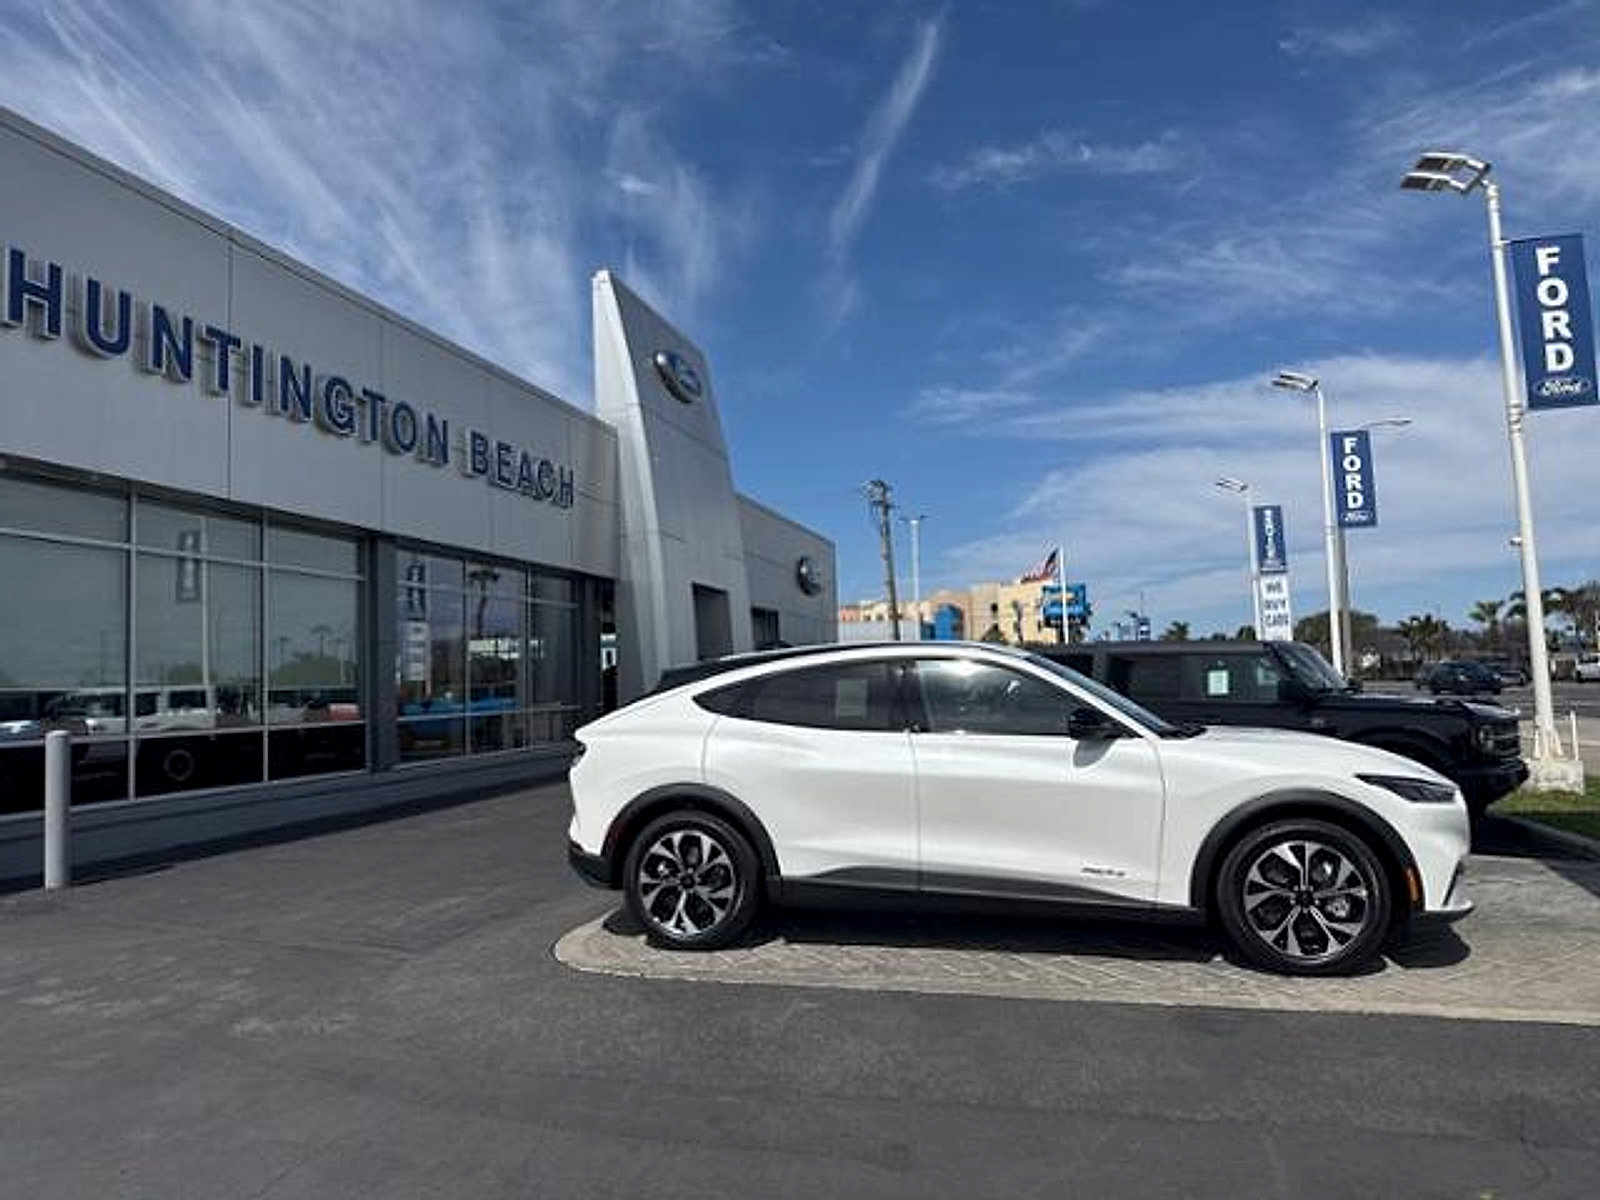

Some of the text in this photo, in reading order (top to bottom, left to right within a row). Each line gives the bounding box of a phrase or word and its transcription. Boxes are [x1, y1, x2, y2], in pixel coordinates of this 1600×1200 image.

[1535, 246, 1574, 373] FORD
[4, 245, 574, 508] HUNTINGTON BEACH
[1342, 437, 1364, 509] FORD
